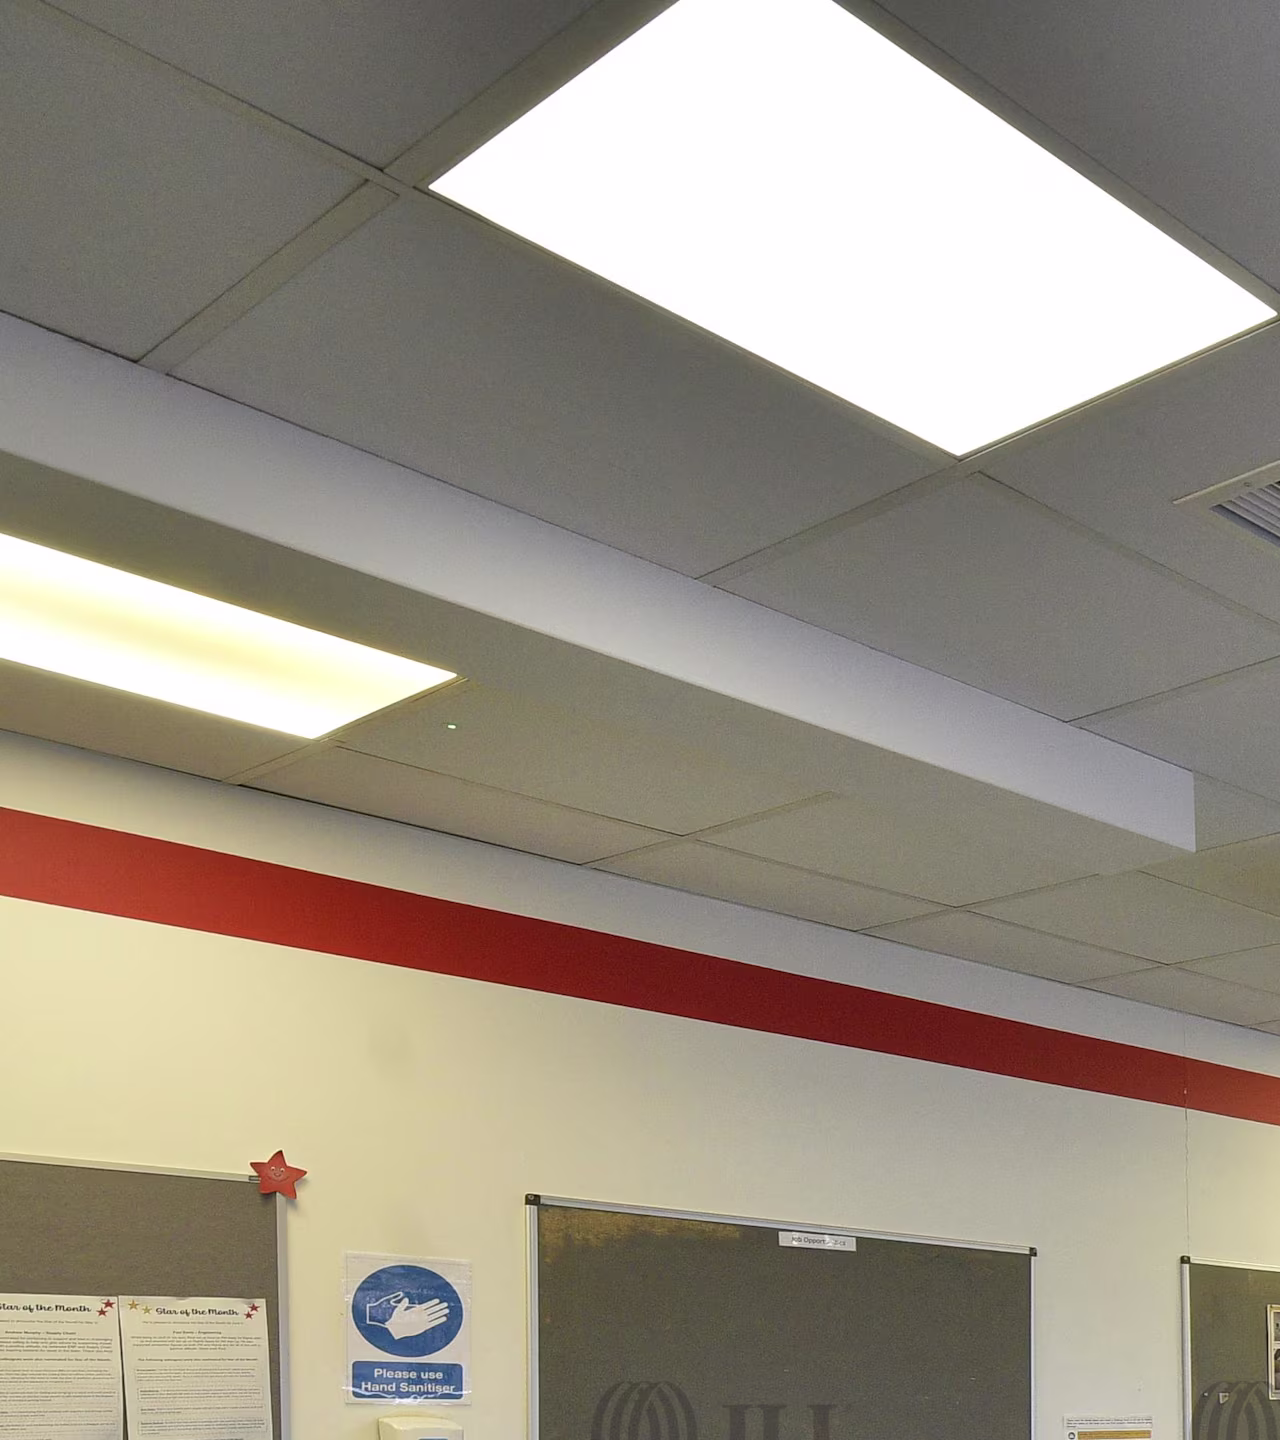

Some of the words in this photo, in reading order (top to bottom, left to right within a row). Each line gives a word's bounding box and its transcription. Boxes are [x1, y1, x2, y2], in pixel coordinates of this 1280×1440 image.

[22, 1305, 34, 1313] of
[36, 1304, 53, 1312] the
[55, 1305, 91, 1313] Month
[155, 1307, 178, 1315] Star
[180, 1309, 191, 1317] of
[208, 1308, 239, 1316] Month
[374, 1368, 417, 1379] Please
[420, 1371, 444, 1379] use
[361, 1382, 396, 1392] Hand
[399, 1382, 456, 1393] Sanitiser
